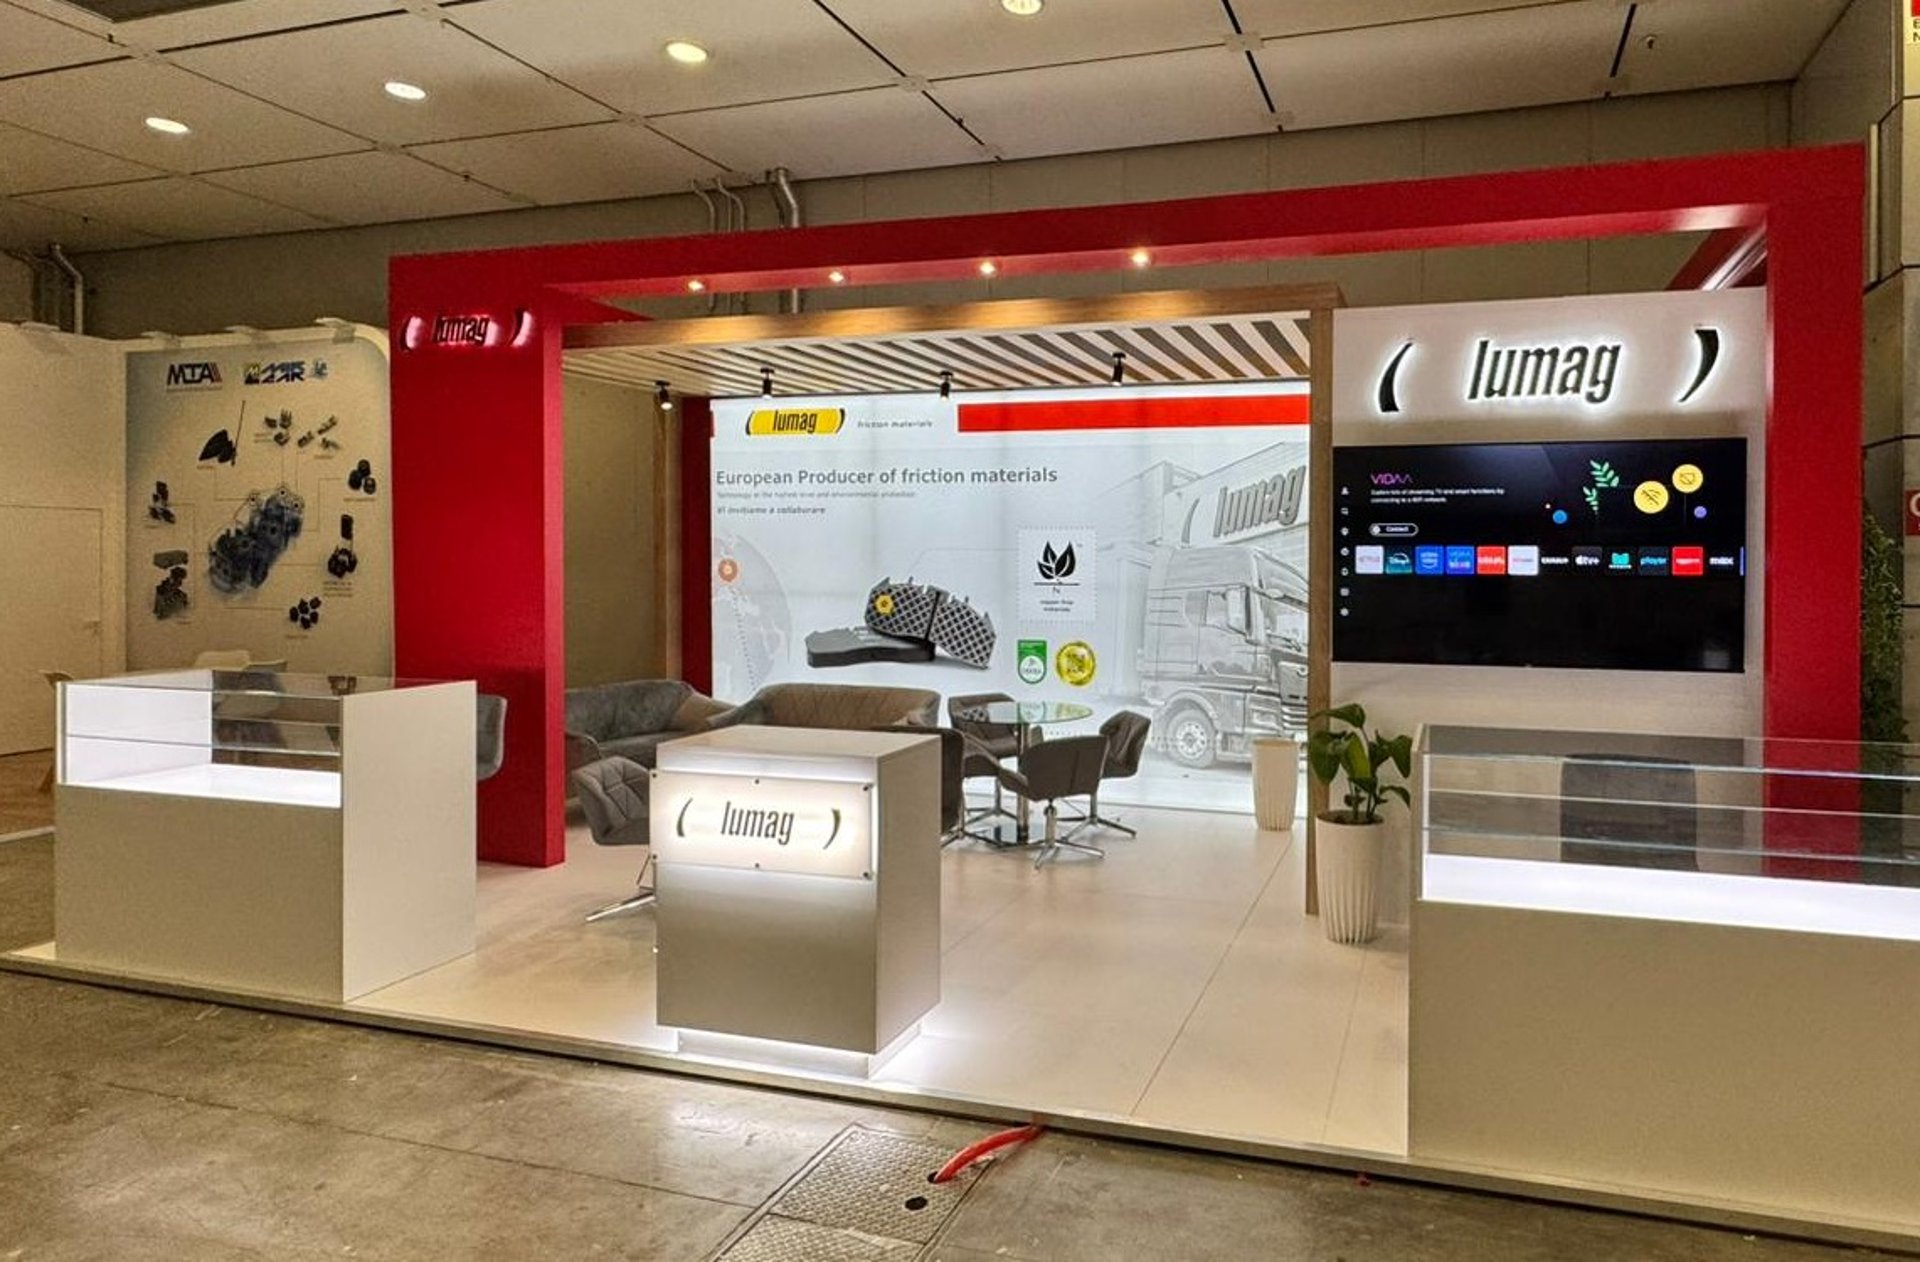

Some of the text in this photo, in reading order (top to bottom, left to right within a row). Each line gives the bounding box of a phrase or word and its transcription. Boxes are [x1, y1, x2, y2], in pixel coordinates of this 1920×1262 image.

[432, 314, 491, 346] lumag
[168, 362, 216, 385] MTA
[1466, 339, 1622, 404] lumag
[772, 409, 818, 435] lumag
[715, 466, 1058, 487] European Producer of friction materials
[1212, 464, 1307, 538] lumag
[720, 800, 795, 847] lumag
